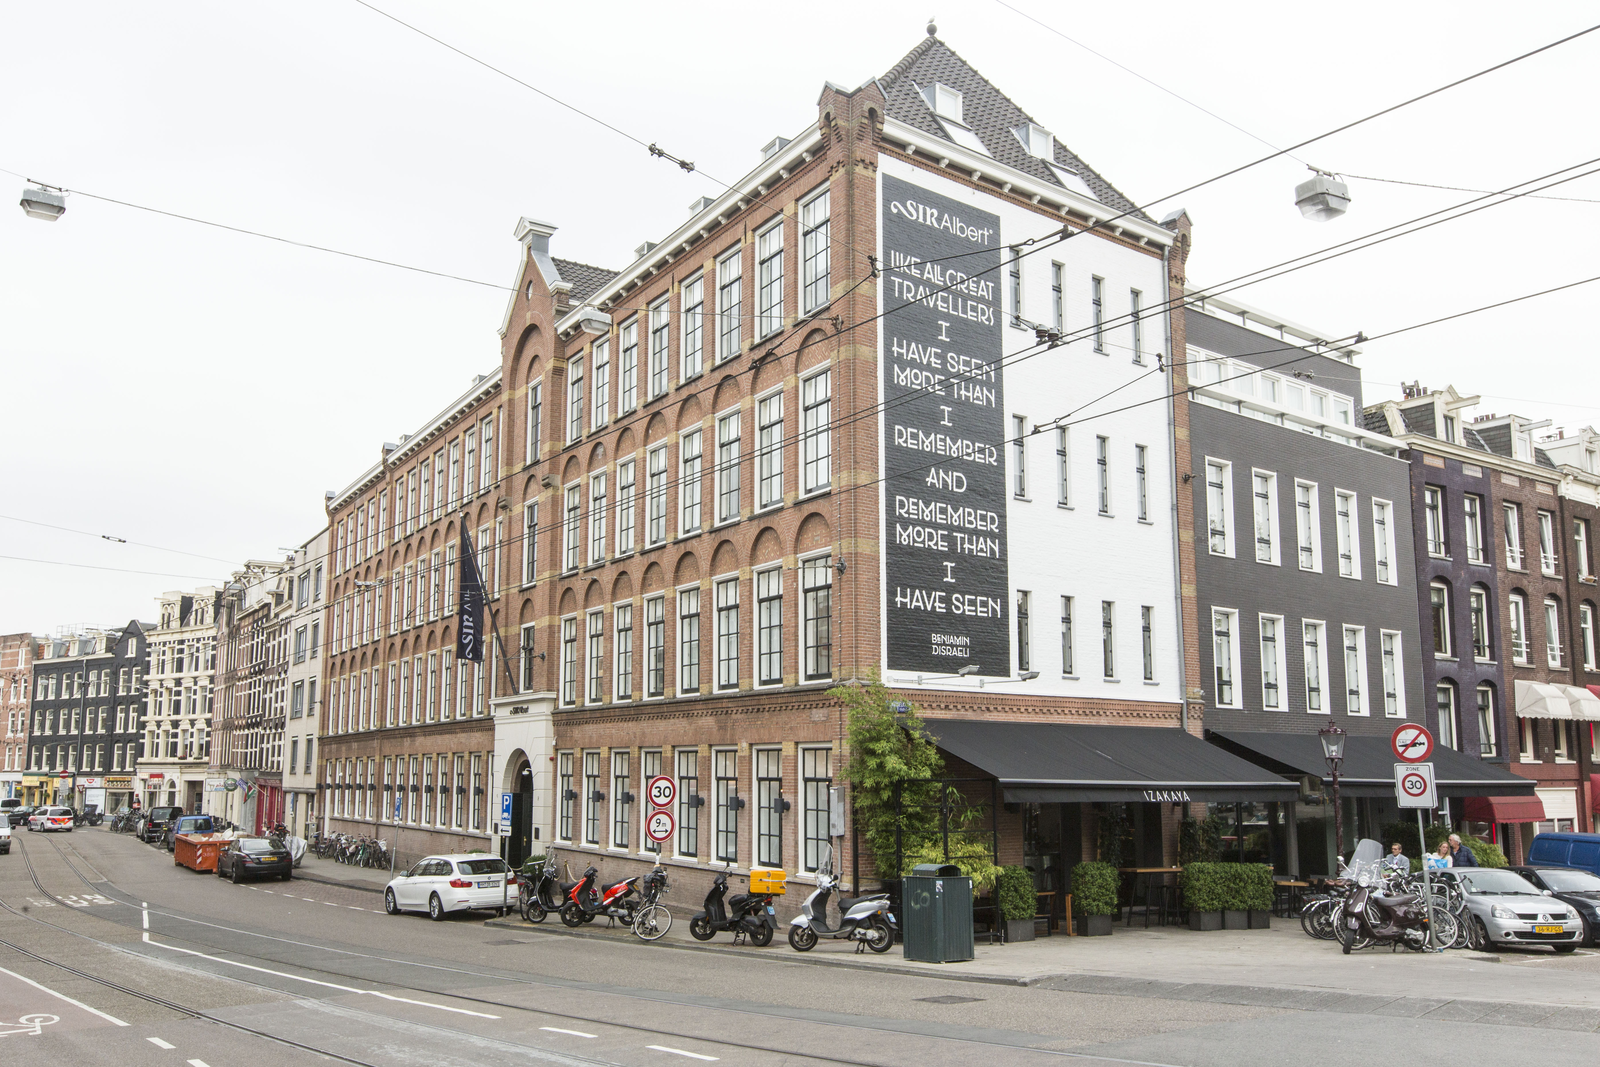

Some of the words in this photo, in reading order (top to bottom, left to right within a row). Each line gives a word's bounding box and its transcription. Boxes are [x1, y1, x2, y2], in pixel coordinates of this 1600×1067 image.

[890, 200, 939, 229] SIR
[891, 250, 920, 277] LIKE
[923, 262, 944, 286] ALL
[946, 270, 994, 300] GREAT
[891, 276, 994, 326] TRAVELLERS
[938, 321, 950, 341] I
[892, 337, 941, 368] HAVE
[947, 353, 995, 383] SEEN
[894, 364, 945, 395] MORE
[950, 379, 995, 408] THAN
[940, 405, 952, 426] I
[894, 425, 997, 466] REMEMBER
[925, 467, 966, 493] AND
[895, 495, 999, 533] REMEMBER
[896, 523, 948, 551] MORE
[953, 532, 999, 559] THAN
[943, 561, 955, 582] I
[895, 587, 946, 612] HAVE
[951, 593, 1001, 618] SEEN
[931, 633, 970, 646] BENJAMIN
[931, 645, 970, 657] DISRAELI
[653, 785, 672, 798] 30
[1143, 790, 1191, 802] IZAKAYA
[1407, 780, 1422, 790] 30
[503, 795, 510, 810] P
